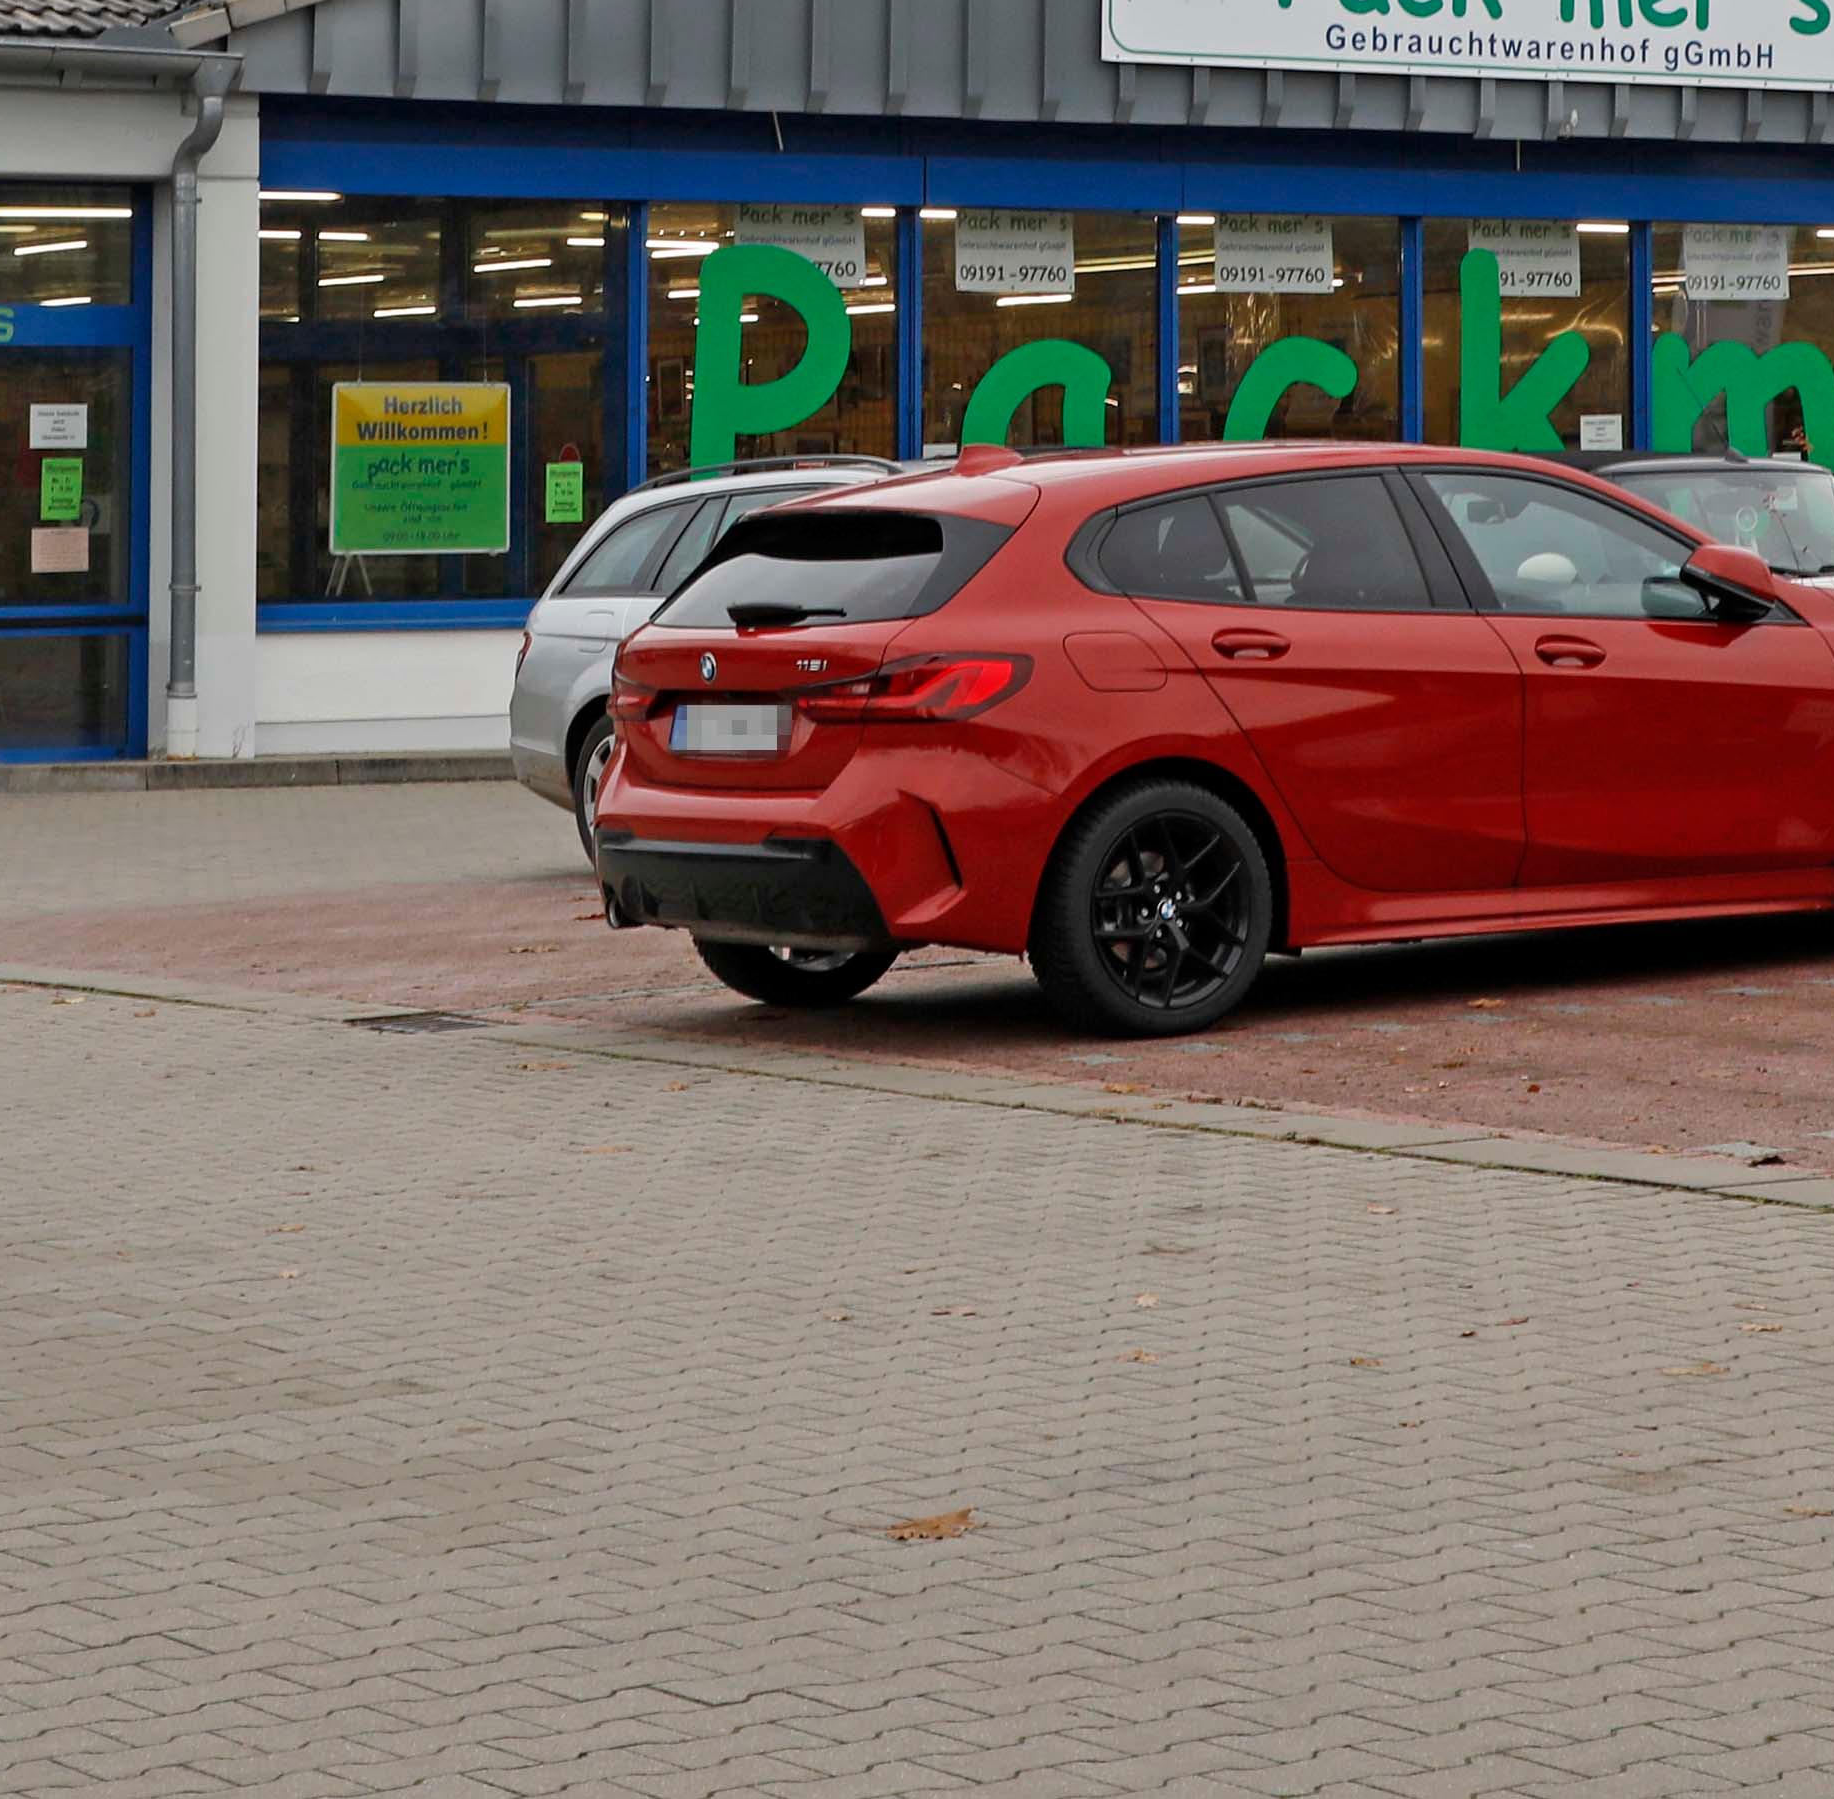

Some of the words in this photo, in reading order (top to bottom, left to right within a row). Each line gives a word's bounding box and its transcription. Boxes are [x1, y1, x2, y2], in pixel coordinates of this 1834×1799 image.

[1325, 23, 1652, 66] Gebrauchtwarenhof
[1665, 38, 1775, 72] gGmbH
[1500, 271, 1573, 287] 91-97760
[384, 395, 463, 416] Herzlich
[357, 421, 488, 441] Willkommen!
